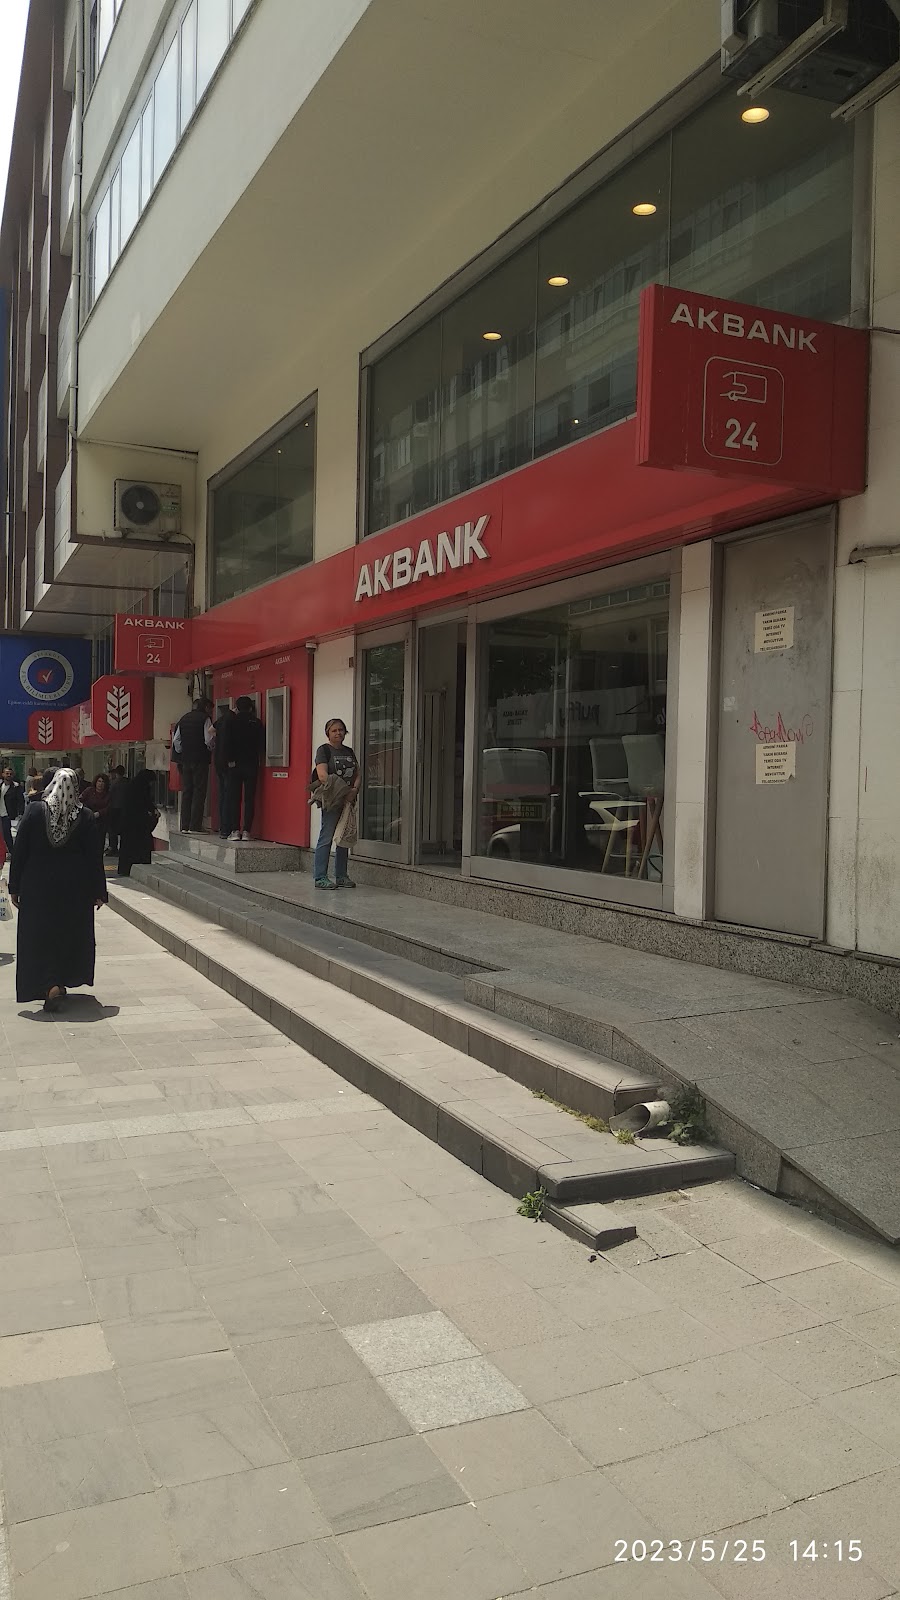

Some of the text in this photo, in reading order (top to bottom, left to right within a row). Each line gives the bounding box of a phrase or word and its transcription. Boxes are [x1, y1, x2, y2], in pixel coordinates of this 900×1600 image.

[671, 303, 818, 354] AKBANK
[725, 418, 758, 451] 24
[355, 514, 491, 602] AKBANK
[124, 618, 185, 630] AKBANK
[146, 653, 161, 664] 24
